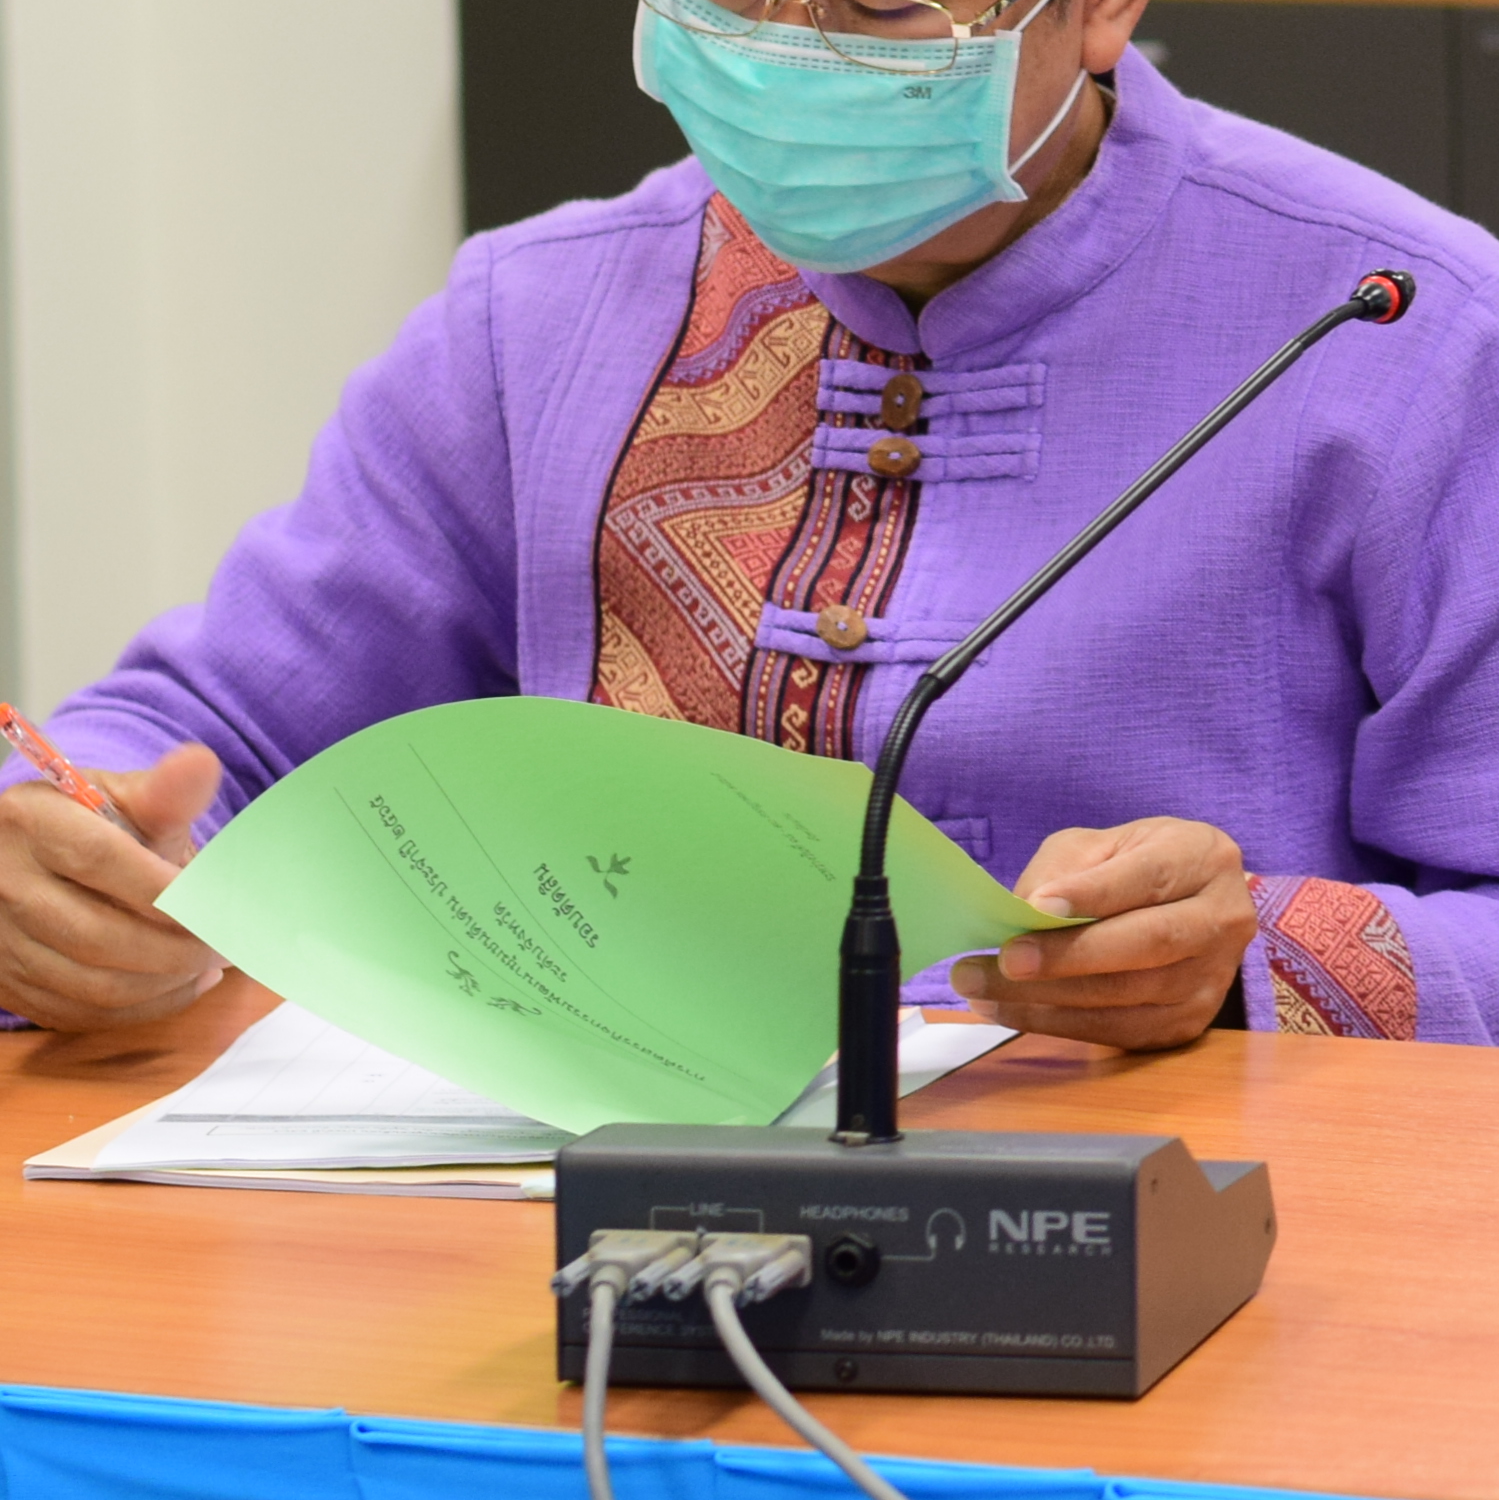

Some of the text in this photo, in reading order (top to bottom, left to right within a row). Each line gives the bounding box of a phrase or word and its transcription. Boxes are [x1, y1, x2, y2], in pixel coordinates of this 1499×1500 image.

[368, 794, 406, 841] ๒๕๖๕
[397, 839, 449, 898] ประจำปี
[533, 862, 600, 949] รอบตัดสิน
[493, 900, 568, 983] ระดับจังหวัด
[690, 1202, 724, 1217] LINE
[800, 1205, 910, 1222] HEADPHONES
[988, 1209, 1111, 1244] NPE
[988, 1243, 1113, 1257] RESEARCH
[820, 1329, 855, 1342] Made
[858, 1331, 874, 1345] by
[877, 1329, 905, 1343] NPE
[908, 1330, 978, 1346] INDUSTRY
[981, 1331, 1058, 1349] (THAILAND)
